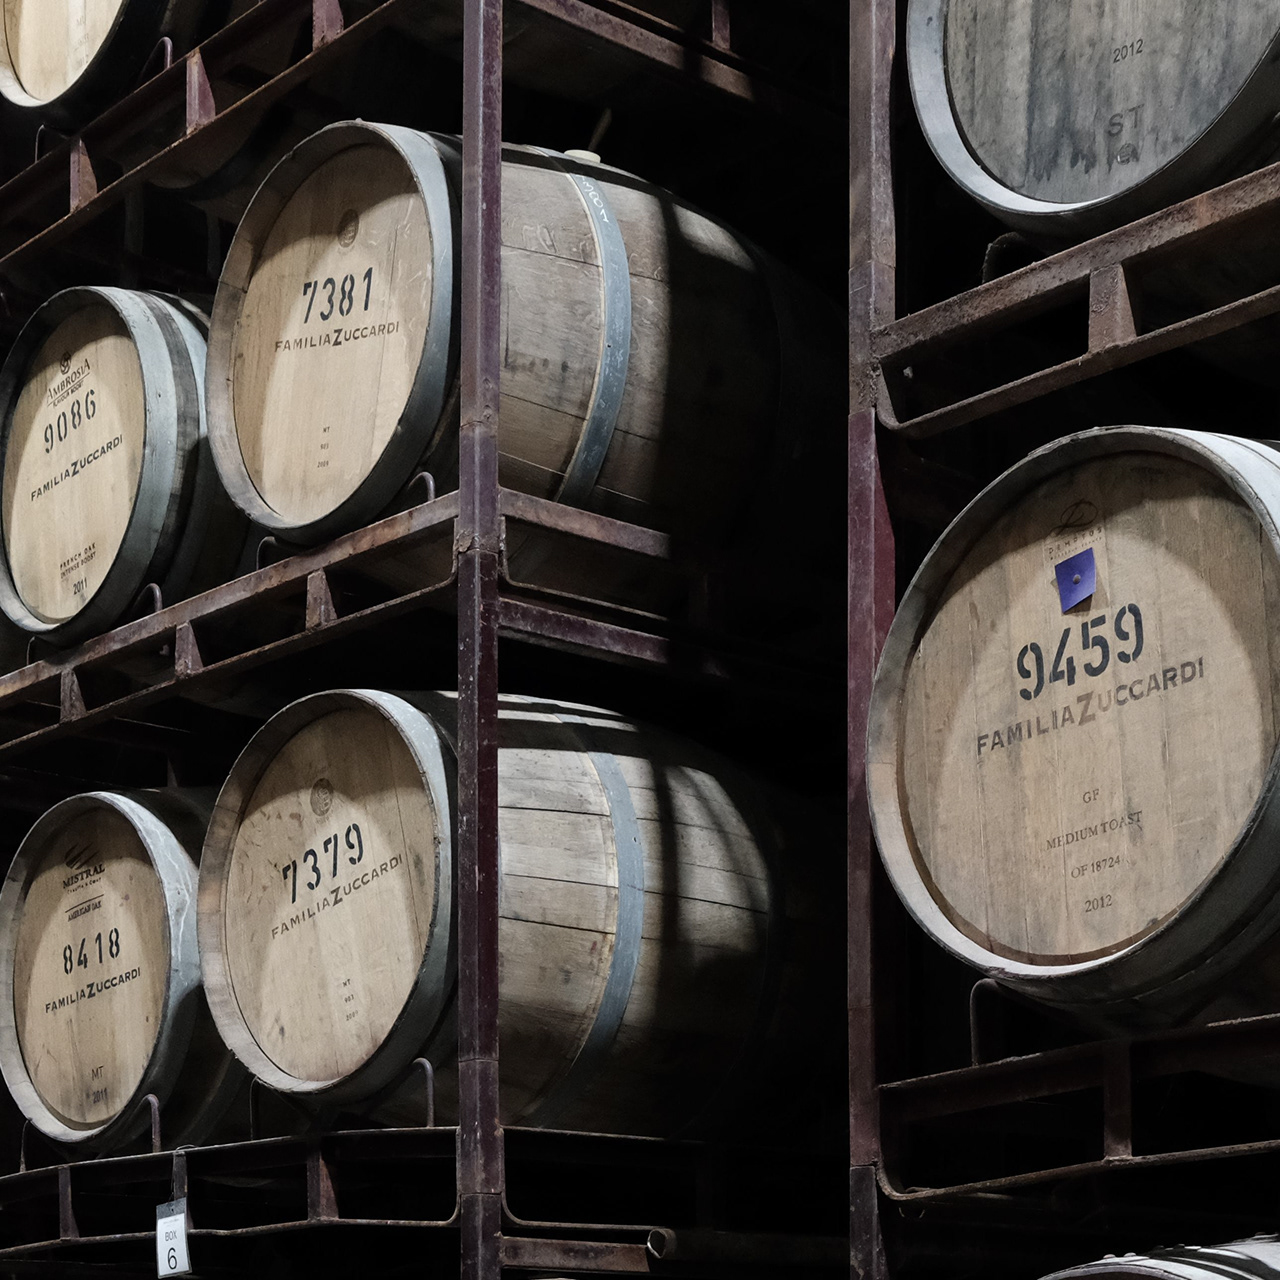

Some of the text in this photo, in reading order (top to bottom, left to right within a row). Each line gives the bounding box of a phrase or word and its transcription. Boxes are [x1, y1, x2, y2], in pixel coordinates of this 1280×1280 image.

[1113, 39, 1144, 63] 2012
[302, 266, 373, 324] 7381
[275, 321, 400, 353] FAMILIAZUCCARDI
[47, 358, 91, 403] AMBROSIA
[44, 389, 96, 454] 9086
[30, 434, 123, 501] FAMILIAZUCCARDI
[73, 577, 87, 595] 2011
[1017, 603, 1145, 701] 9459
[976, 656, 1205, 757] FAMILIAZUCCARDI
[1083, 788, 1100, 803] GF
[1046, 811, 1143, 850] MEDIUM TOAST
[63, 864, 106, 889] MISTRAL
[282, 823, 363, 904] 7379
[1071, 855, 1121, 879] OF 18724
[271, 854, 403, 940] FAMILIAZUCCARDI
[1085, 894, 1112, 913] 2012
[62, 928, 120, 975] 8418
[45, 967, 141, 1014] FAMILIAZUCCARDI
[165, 1230, 177, 1241] BOX
[167, 1247, 177, 1270] 6
